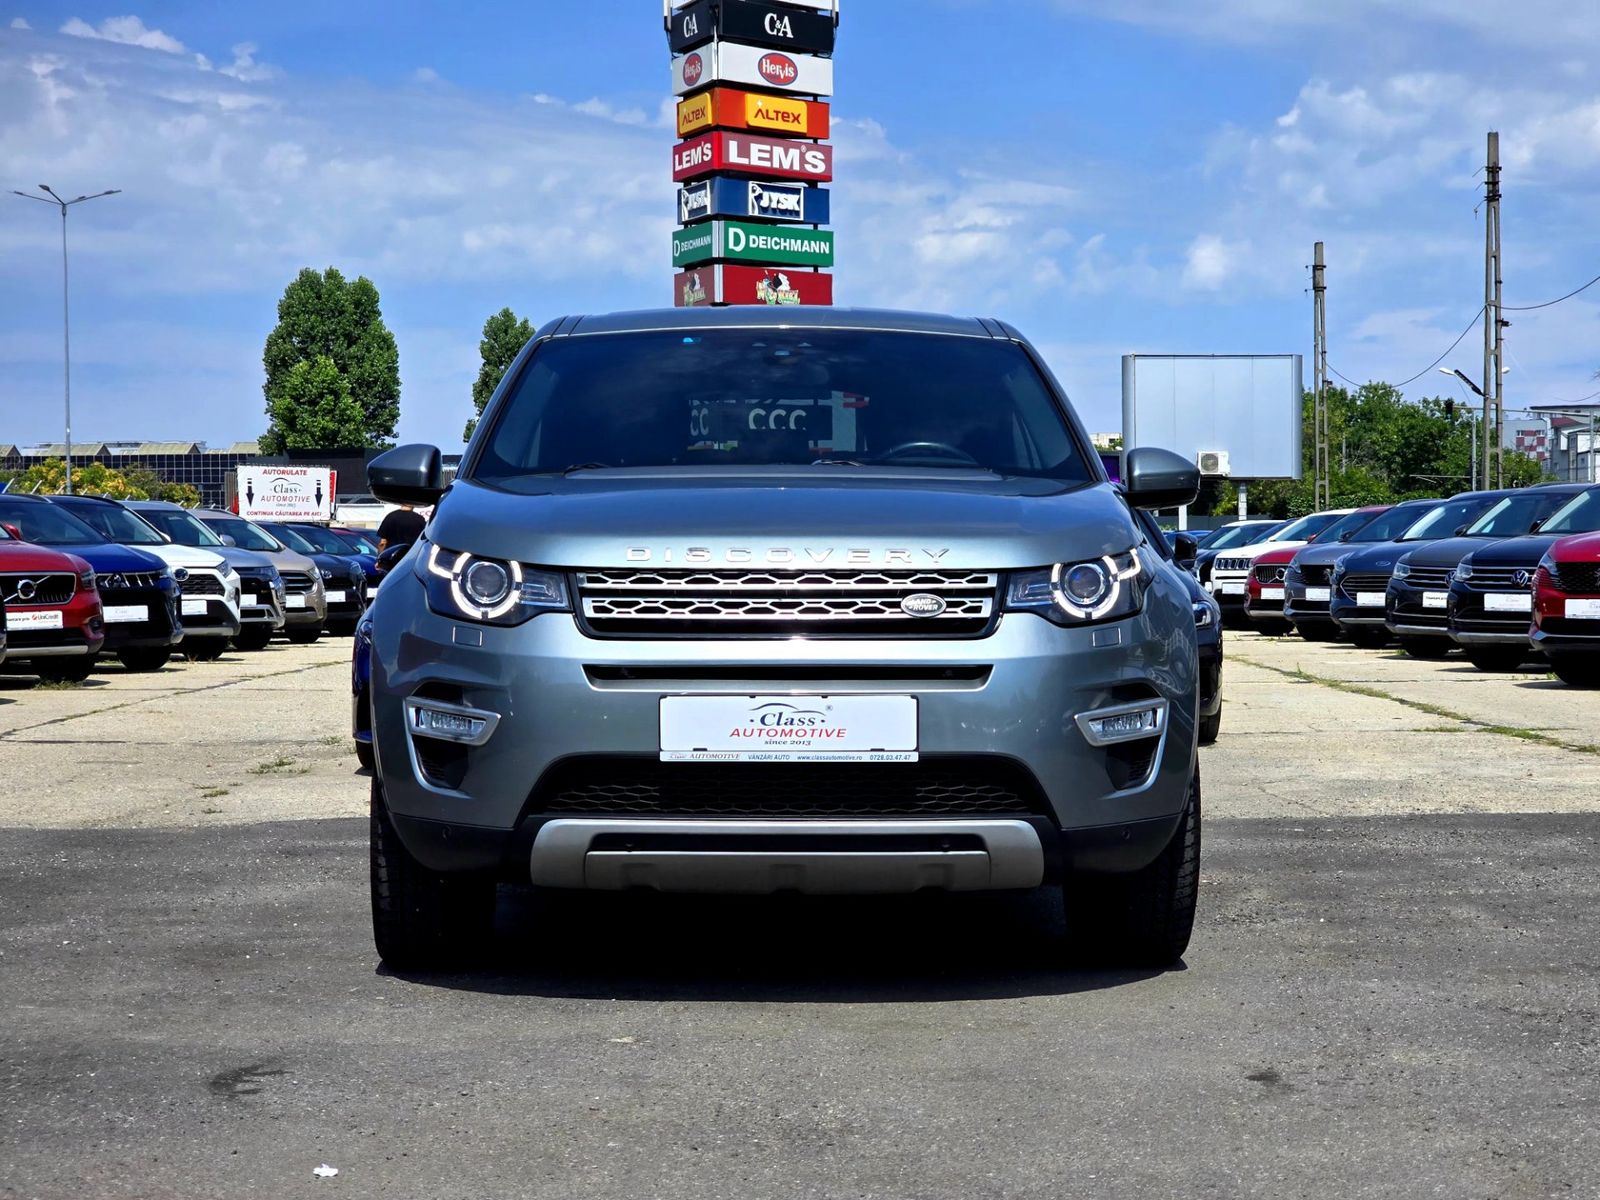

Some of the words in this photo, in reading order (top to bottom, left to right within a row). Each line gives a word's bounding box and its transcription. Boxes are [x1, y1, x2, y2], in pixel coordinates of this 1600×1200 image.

[683, 13, 698, 38] C&A
[764, 12, 794, 39] C&A
[762, 57, 795, 80] Hervis
[674, 142, 712, 172] LEM'S
[728, 140, 826, 174] LEM'S
[760, 191, 800, 212] JYSK
[681, 234, 712, 252] DEICHMANN
[749, 234, 830, 255] DEICHMANN
[262, 468, 308, 476] AUTORULATE
[273, 484, 298, 494] Class
[625, 546, 950, 564] DISCOVERY
[759, 711, 816, 727] Class
[729, 728, 847, 738] AUTOMOTIVE
